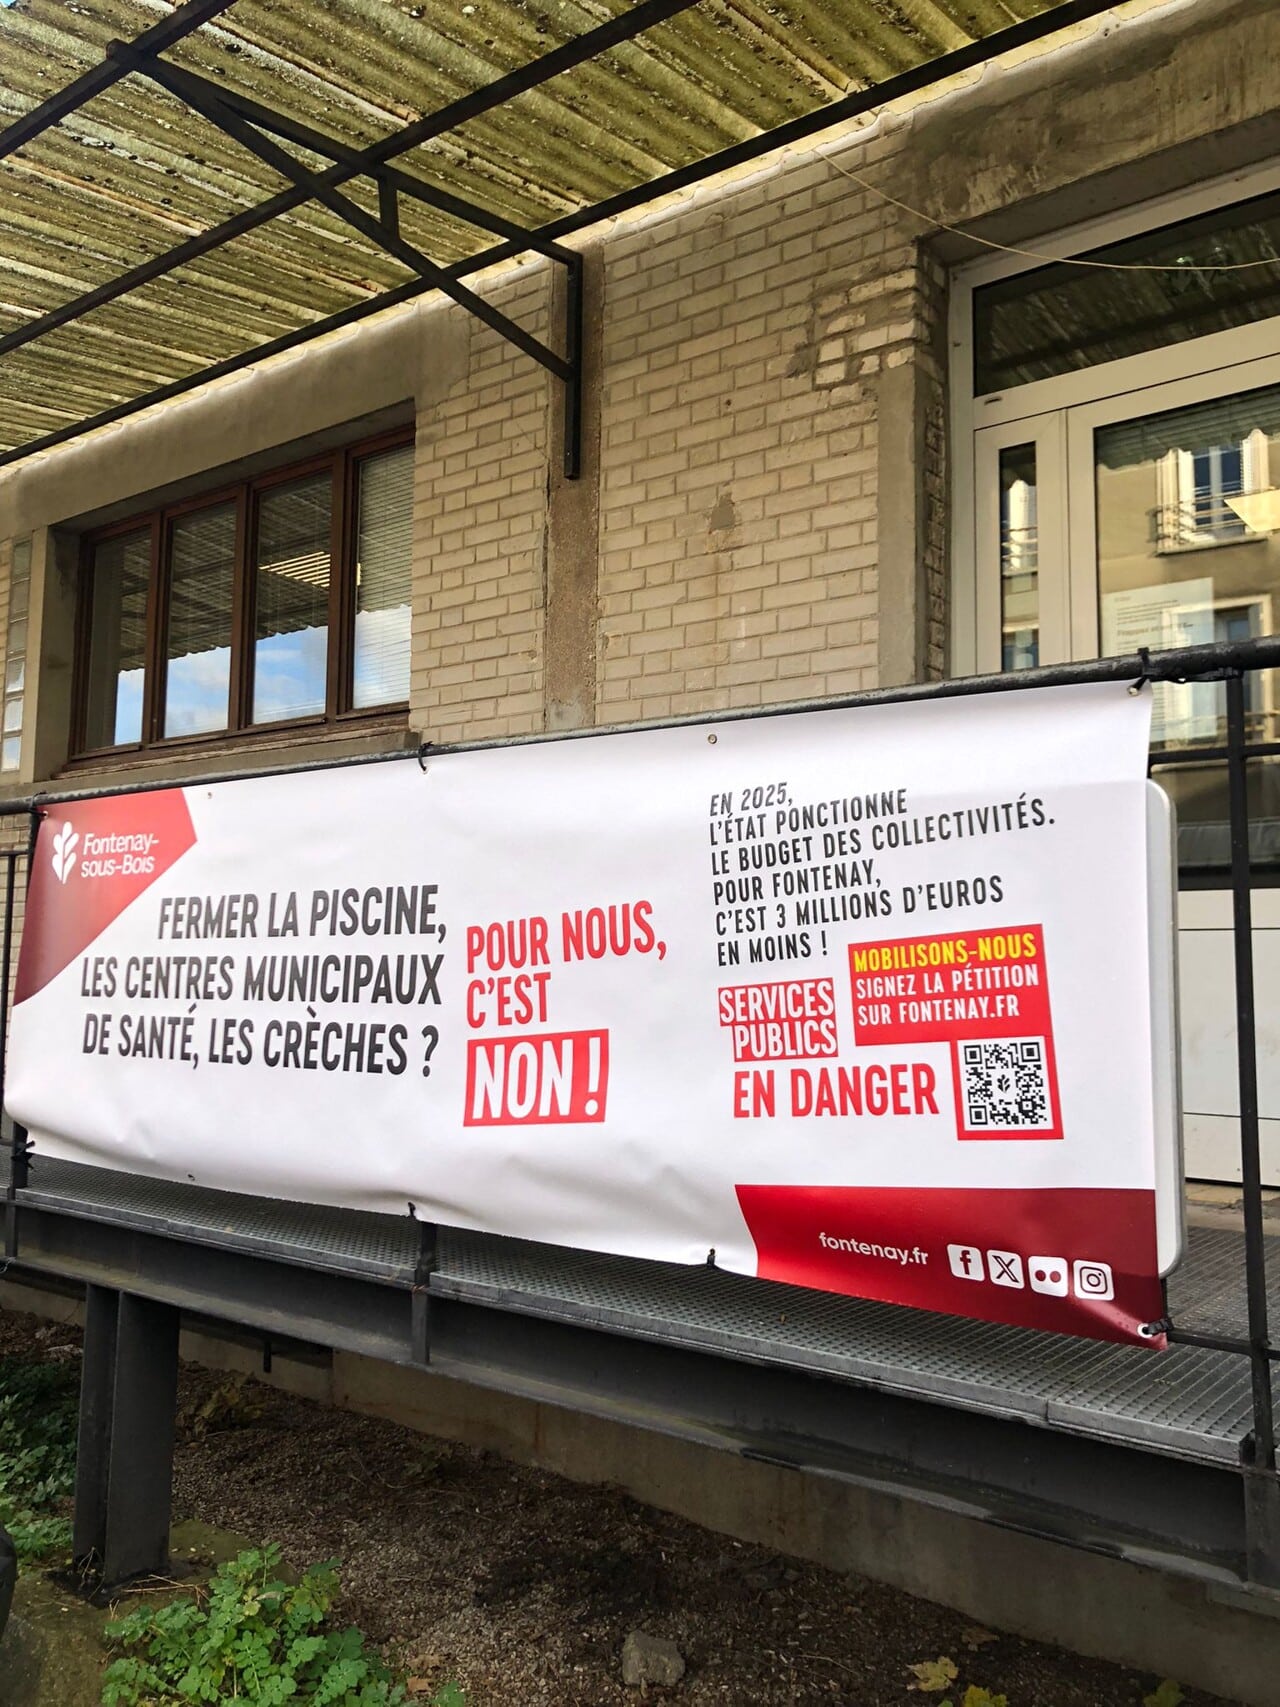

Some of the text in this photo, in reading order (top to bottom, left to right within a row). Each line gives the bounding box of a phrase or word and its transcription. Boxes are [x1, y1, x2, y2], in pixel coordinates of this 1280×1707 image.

[709, 782, 794, 817] EN 2025,
[776, 788, 908, 836] PONCTIONNE
[82, 832, 159, 857] Fontenay-
[711, 791, 1056, 876] LE BUDGET DES COLLECTIVITÉS.
[81, 854, 154, 878] sous-Bois
[713, 858, 882, 905] POUR FONTENAY,
[158, 884, 447, 944] FERMER LA PISCINE,
[776, 904, 787, 929] 3
[796, 889, 891, 927] MILLIONS
[467, 900, 667, 974] POUR NOUS,
[717, 930, 827, 967] EN MOINS !
[853, 932, 1037, 973] MOBILISONS-NOUS
[81, 954, 445, 1005] LES CENTRES MUNICIPAUX
[856, 963, 1039, 1000] SIGNEZ LA PÉTITION
[719, 980, 834, 1023] SERVICES
[858, 994, 1020, 1026] SUR FONTENAY.FR
[82, 1003, 440, 1078] DE SANTÉ, LES CRÈCHES ?
[734, 1019, 837, 1059] PUBLICS
[472, 1037, 601, 1120] NON !
[733, 1063, 940, 1119] EN DANGER
[819, 1231, 928, 1265] fontenay.fr
